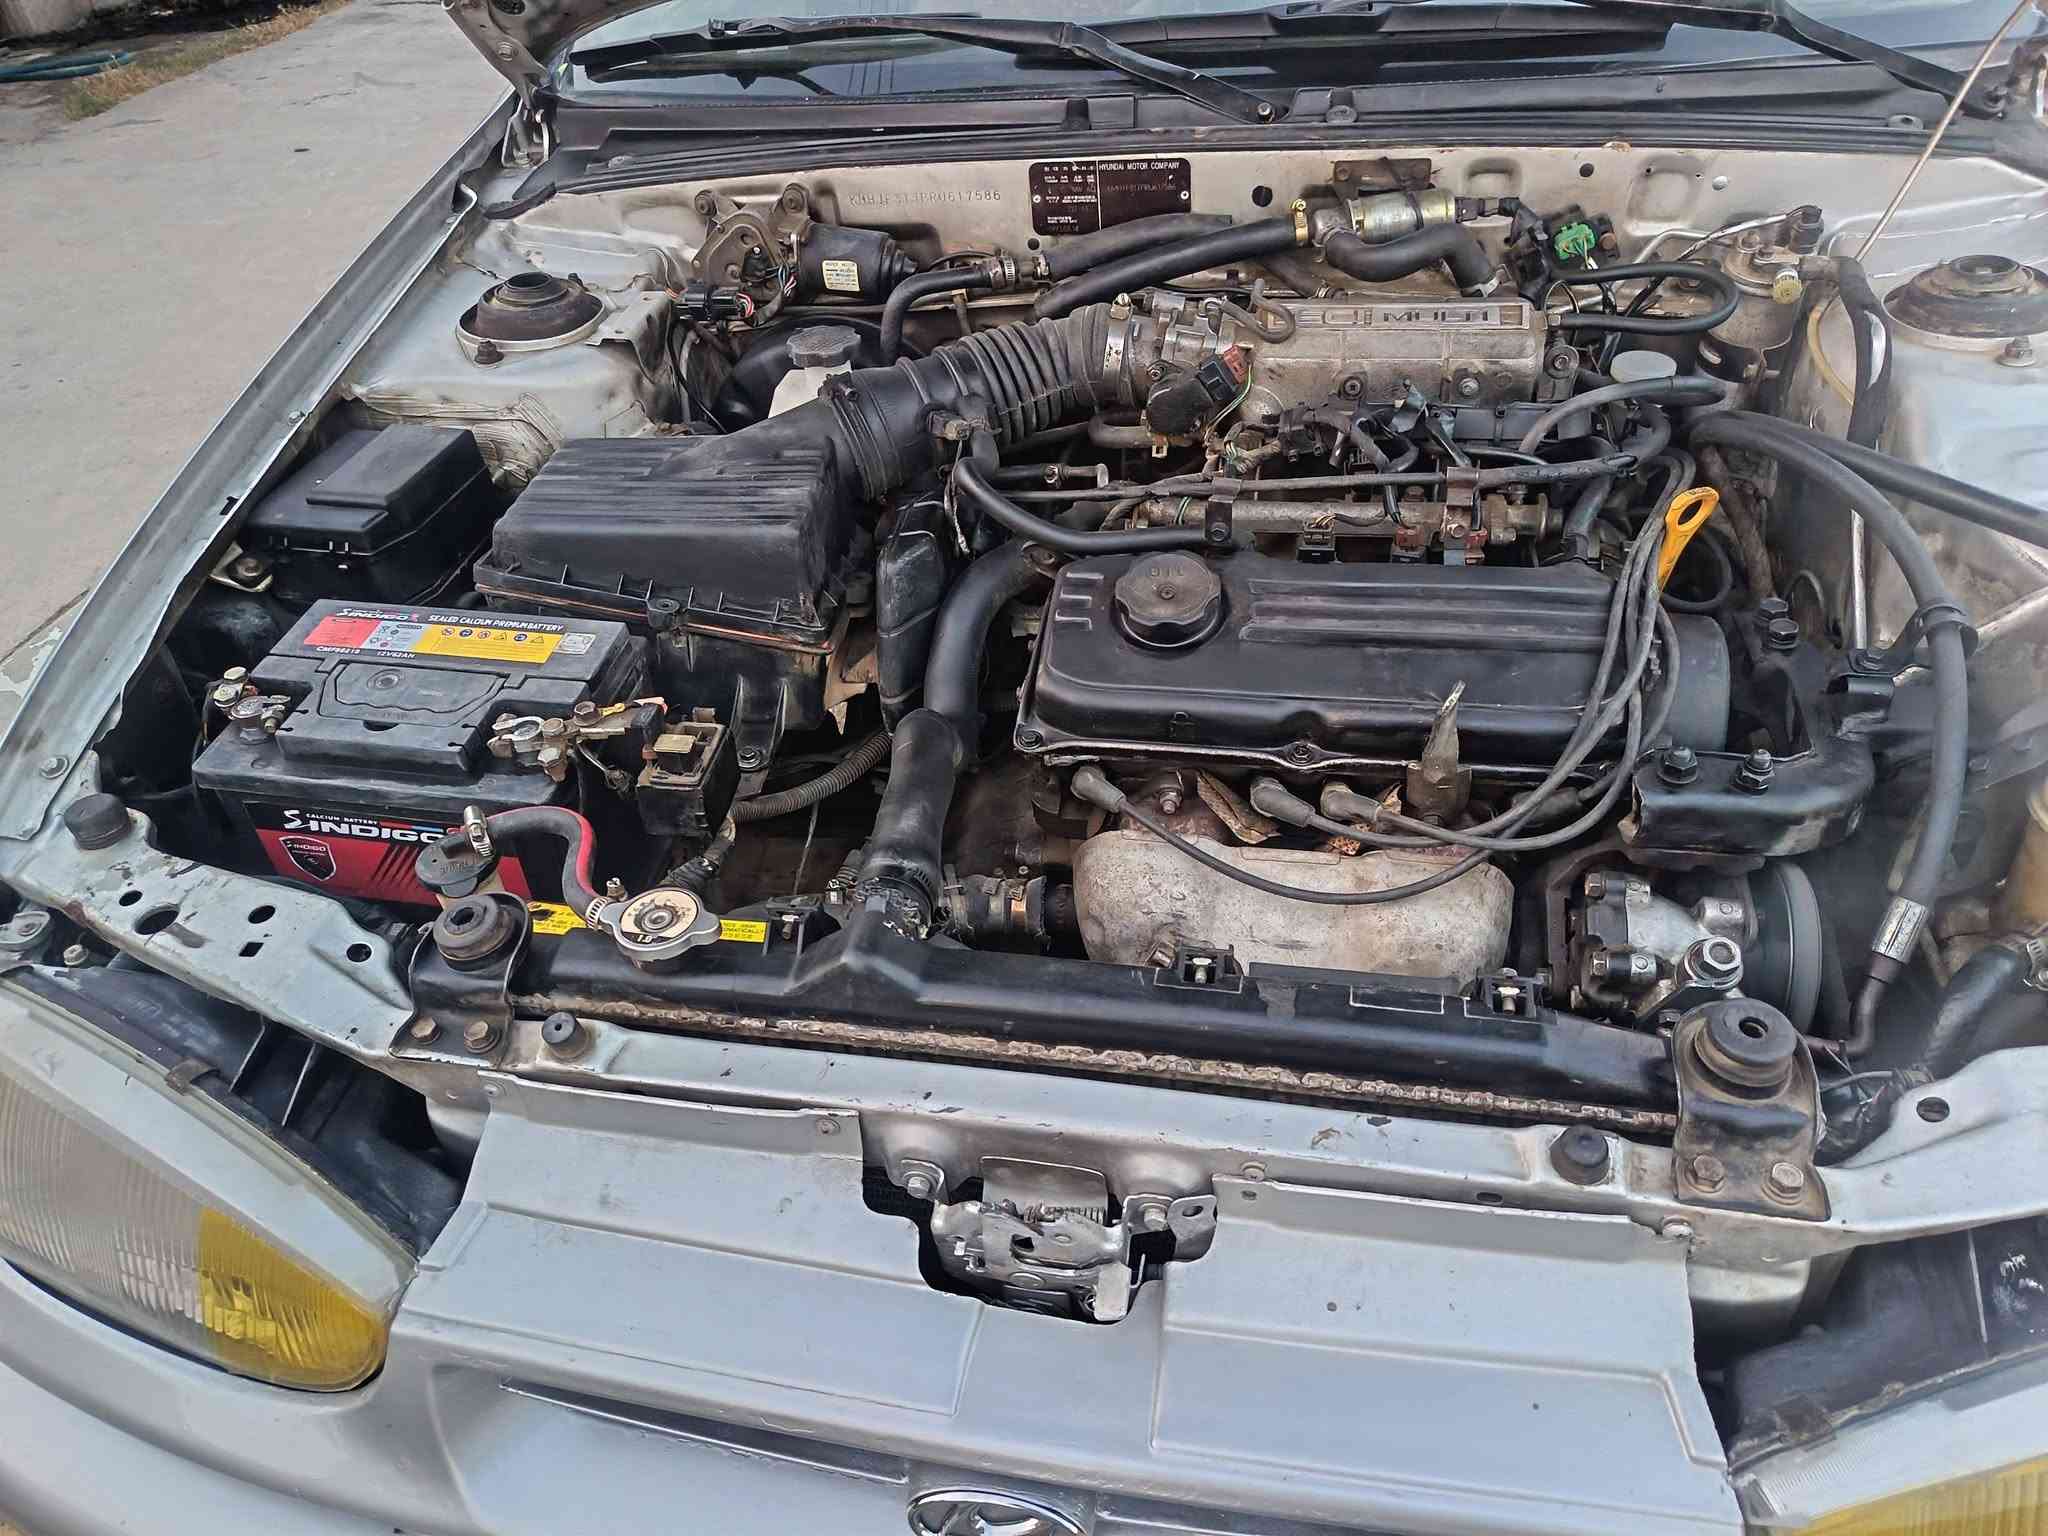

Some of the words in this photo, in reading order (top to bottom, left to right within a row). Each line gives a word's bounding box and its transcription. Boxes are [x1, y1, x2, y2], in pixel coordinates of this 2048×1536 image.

[1099, 163, 1124, 171] HYUNDAI
[1127, 162, 1148, 170] MOTOR
[1150, 161, 1180, 170] COMPANY
[429, 614, 458, 623] SEALED
[459, 616, 492, 626] CALCIUM
[492, 619, 528, 630] PREMIUM
[527, 623, 564, 632] BATTERY
[305, 812, 340, 821] CALCIUM
[343, 817, 378, 825] BATTERY
